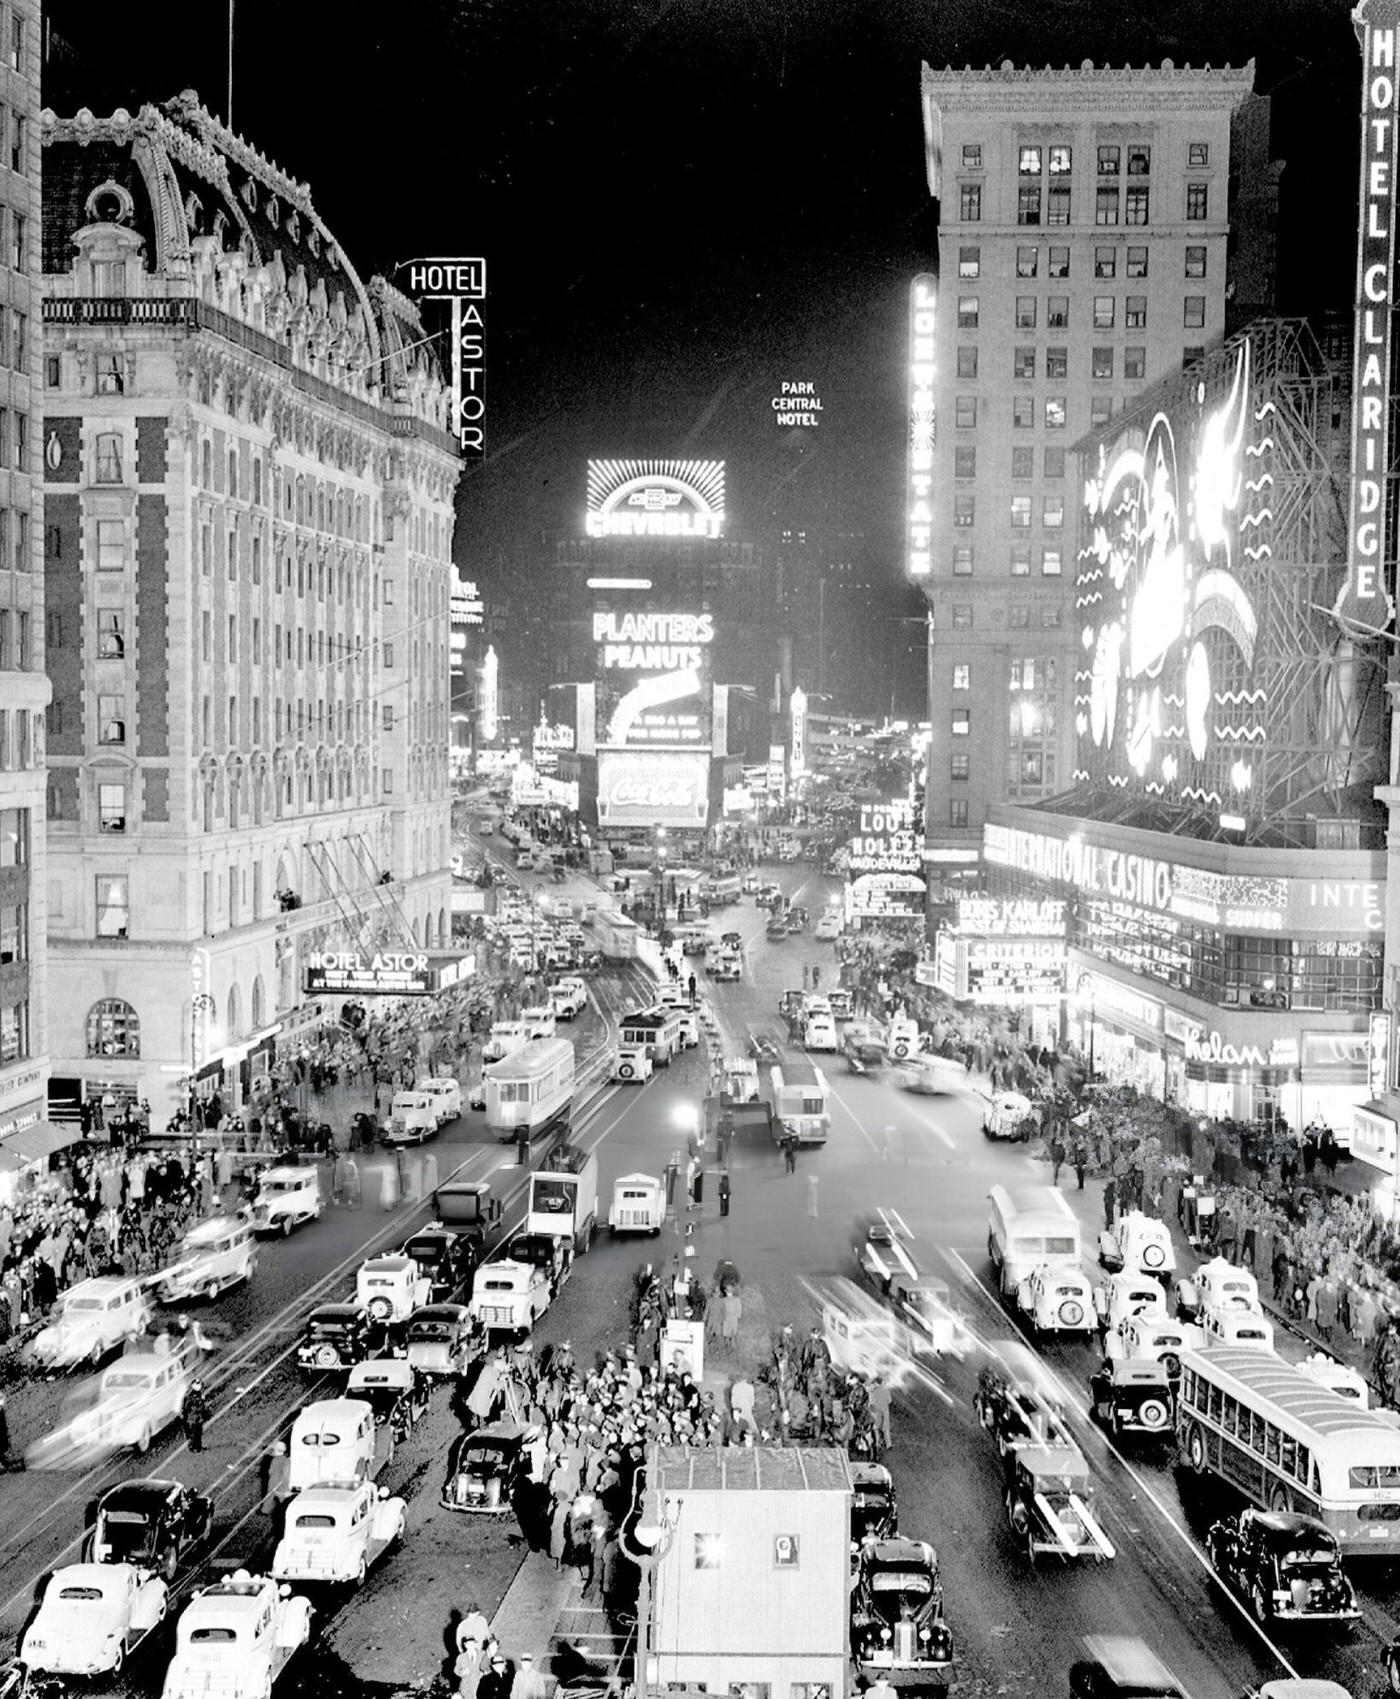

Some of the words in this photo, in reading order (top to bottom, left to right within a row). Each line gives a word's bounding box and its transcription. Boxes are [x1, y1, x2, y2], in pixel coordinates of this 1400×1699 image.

[1369, 29, 1393, 238] HOTEL
[411, 266, 482, 290] HOTEL
[460, 304, 485, 451] ASTOR
[781, 382, 815, 394] PARK
[771, 397, 823, 410] CENTRAL
[777, 413, 818, 426] HOTEL
[1357, 264, 1387, 598] CLARIDGE
[585, 511, 725, 538] CHEVROLET
[593, 613, 714, 643] PLANTERS
[605, 645, 702, 670] PEANUTS
[861, 814, 899, 832] LOU
[853, 837, 913, 857] HOLTZ
[1007, 828, 1101, 891] INTERNATIONAL
[1107, 849, 1171, 909] CASINO
[960, 899, 999, 920] BORIS
[1003, 900, 1066, 920] KARLOFF
[1008, 920, 1065, 935] SHANGHAI
[974, 943, 1065, 957] CRITERION
[310, 952, 365, 970] HOTEL
[372, 953, 429, 971] ASTOR
